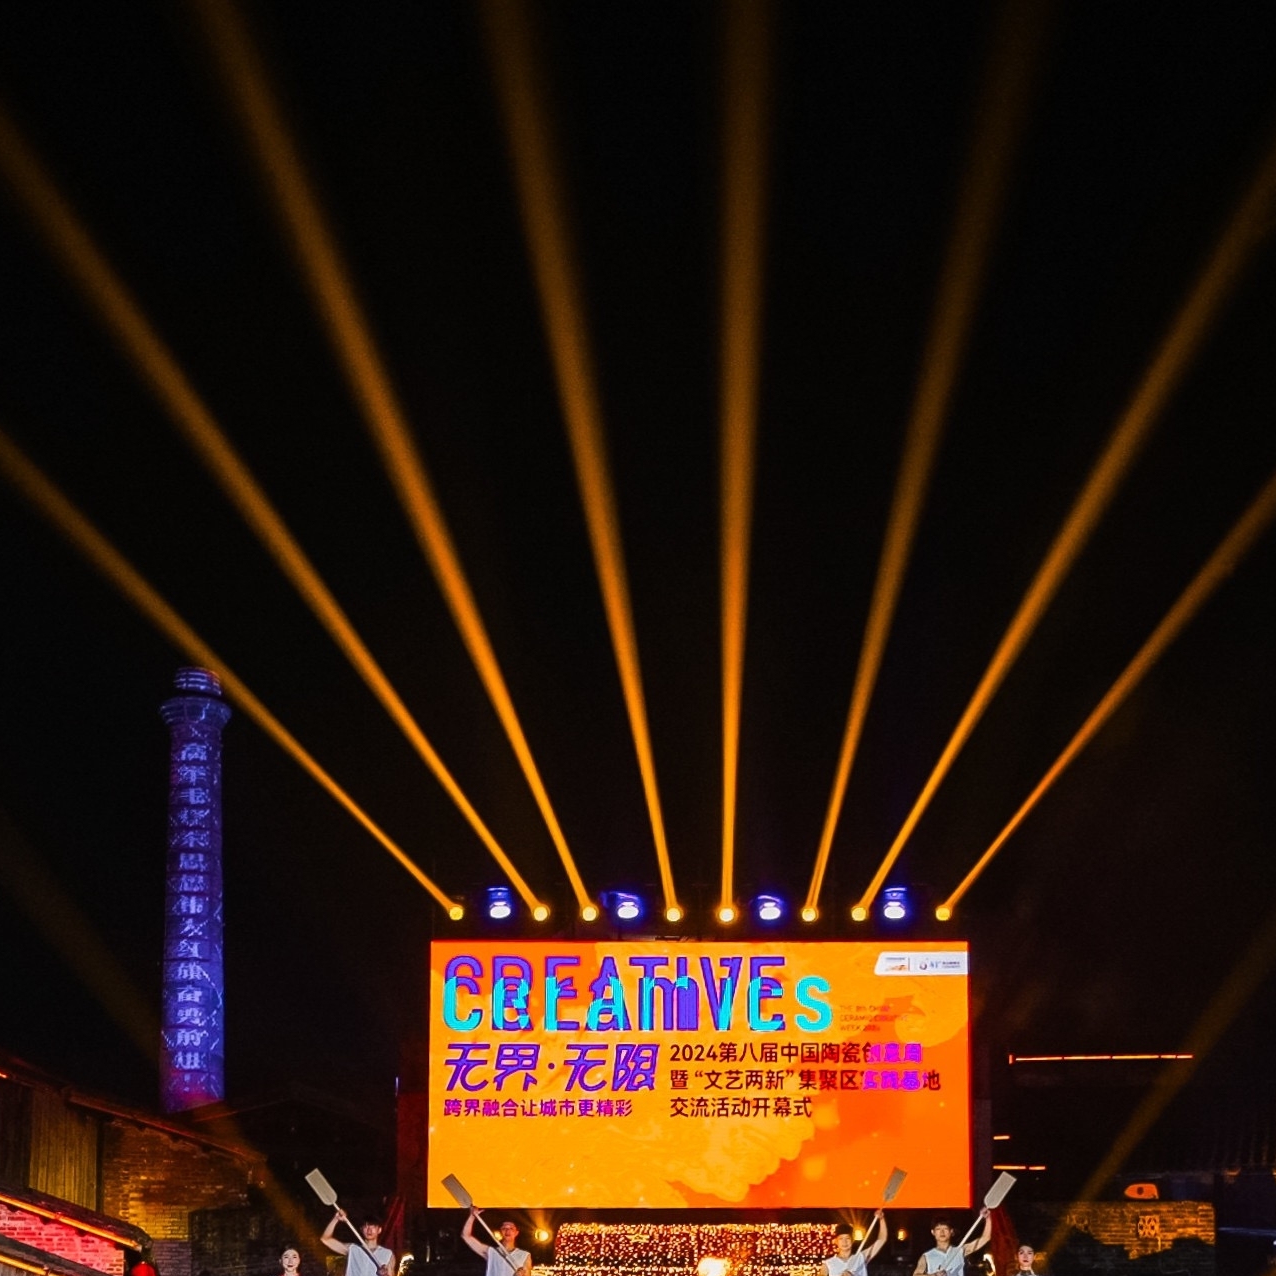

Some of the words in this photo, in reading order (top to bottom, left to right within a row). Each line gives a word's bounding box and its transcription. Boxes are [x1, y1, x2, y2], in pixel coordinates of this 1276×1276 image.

[669, 1041, 923, 1063] 2024第八届中国陶瓷创意周
[443, 1098, 632, 1117] 跨界融合让城市更精彩
[669, 1096, 813, 1118] 交流活动开幕式
